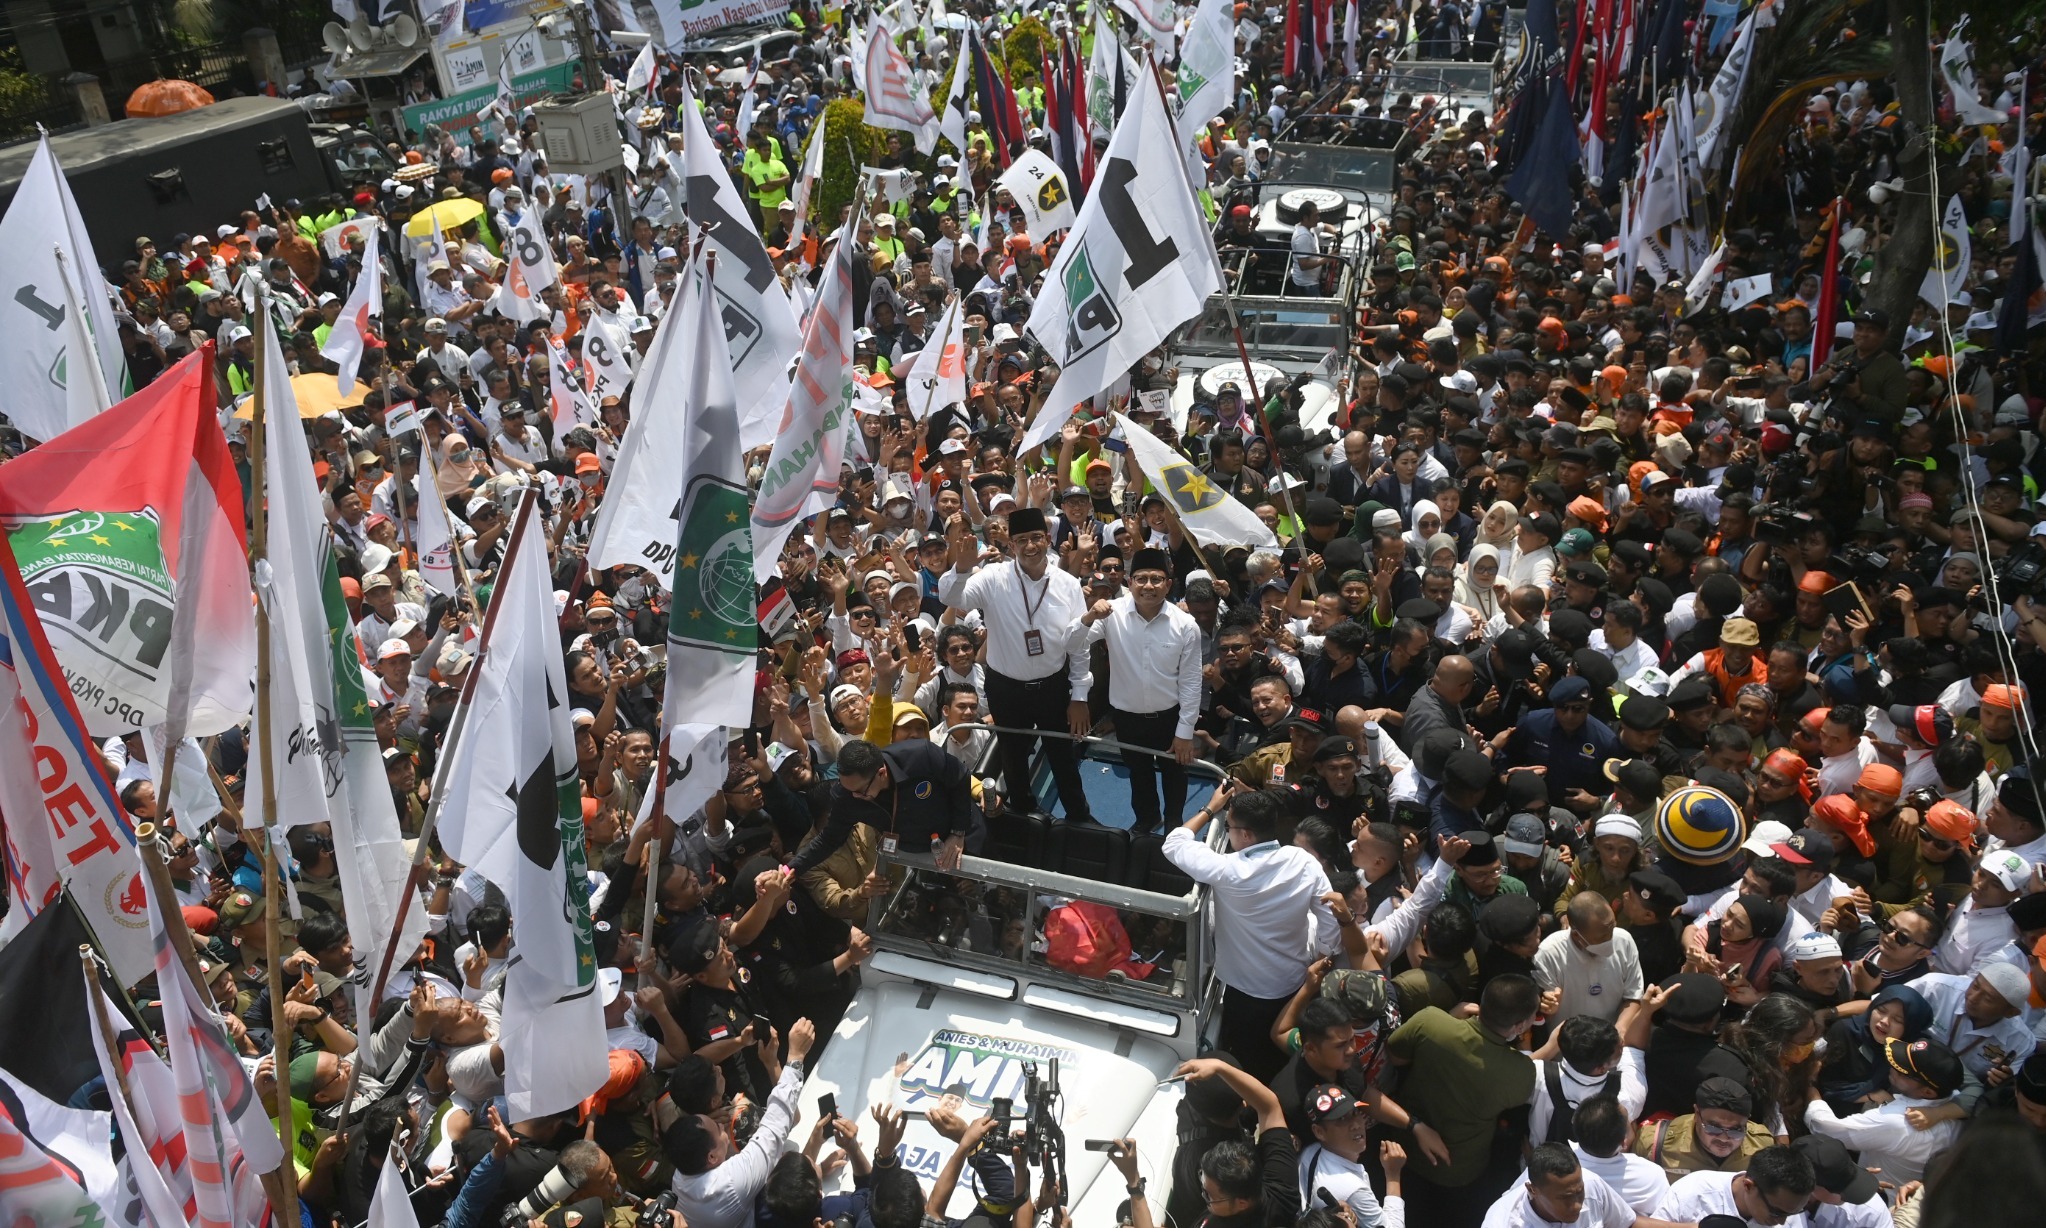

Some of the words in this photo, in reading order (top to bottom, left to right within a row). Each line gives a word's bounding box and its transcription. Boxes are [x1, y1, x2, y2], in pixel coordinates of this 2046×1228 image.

[681, 13, 722, 35] Barisan
[722, 1, 764, 24] Nasional
[466, 60, 485, 74] AMIN
[419, 105, 463, 125] RAKYAT
[465, 93, 495, 112] BUTUH
[1028, 166, 1045, 180] 24
[1098, 156, 1180, 292] 1
[515, 227, 543, 267] 8
[588, 336, 613, 367] 8
[936, 1031, 976, 1046] ANIES
[978, 1036, 989, 1048] &
[991, 1038, 1081, 1064] MUHAIMIN
[902, 1045, 1048, 1109] AMI
